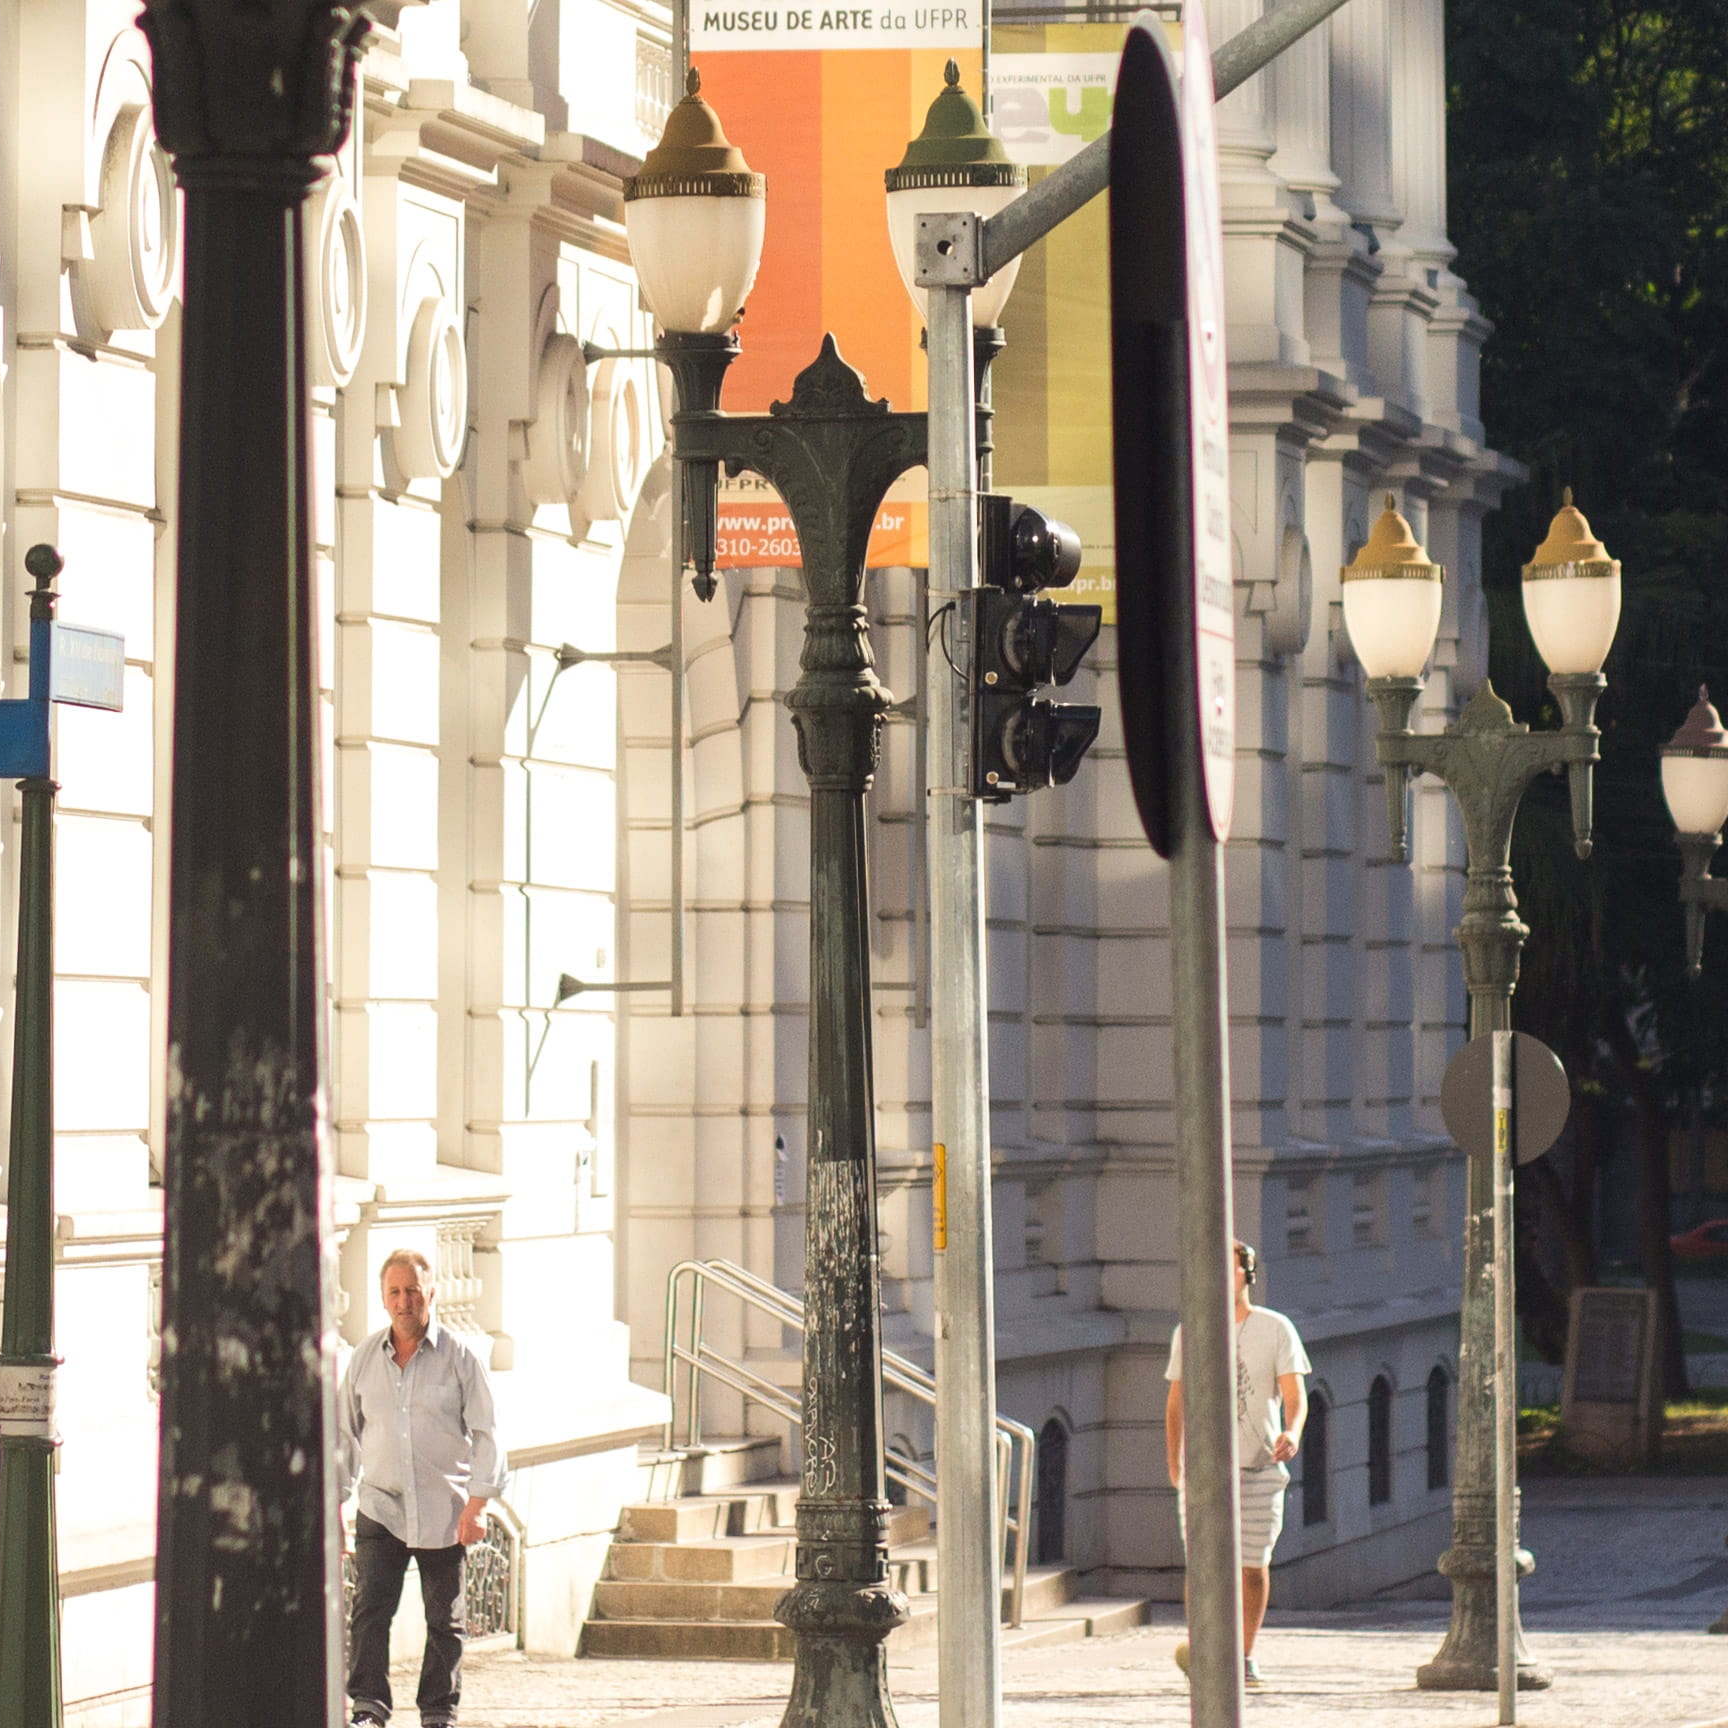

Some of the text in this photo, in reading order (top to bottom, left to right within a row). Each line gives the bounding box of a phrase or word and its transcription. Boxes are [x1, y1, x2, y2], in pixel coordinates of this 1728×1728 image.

[703, 8, 969, 32] MUSEU DE ARTE da UFPR
[997, 74, 1064, 84] EXPERIMENTAL
[1067, 74, 1081, 83] DA
